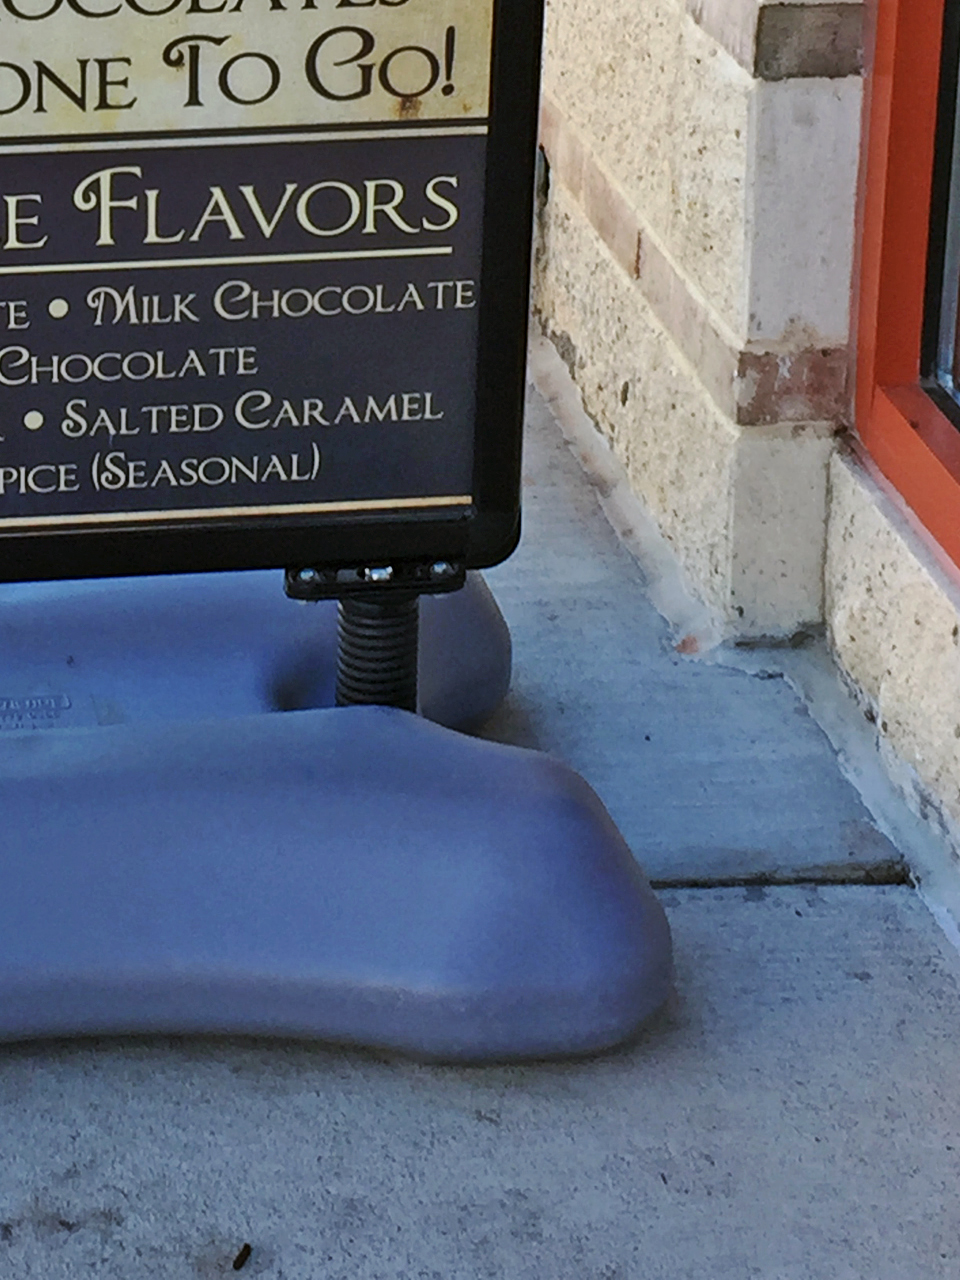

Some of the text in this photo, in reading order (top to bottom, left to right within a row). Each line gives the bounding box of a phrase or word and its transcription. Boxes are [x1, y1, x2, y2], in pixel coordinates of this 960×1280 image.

[163, 35, 280, 107] TO
[305, 26, 455, 103] GO!
[74, 167, 459, 246] FLAVORS
[87, 286, 199, 325] MILK
[214, 281, 475, 319] CHOCOLATE
[62, 400, 223, 437] SALTED
[235, 391, 443, 428] CARAMEL
[92, 443, 319, 490] (SEASONAL)
